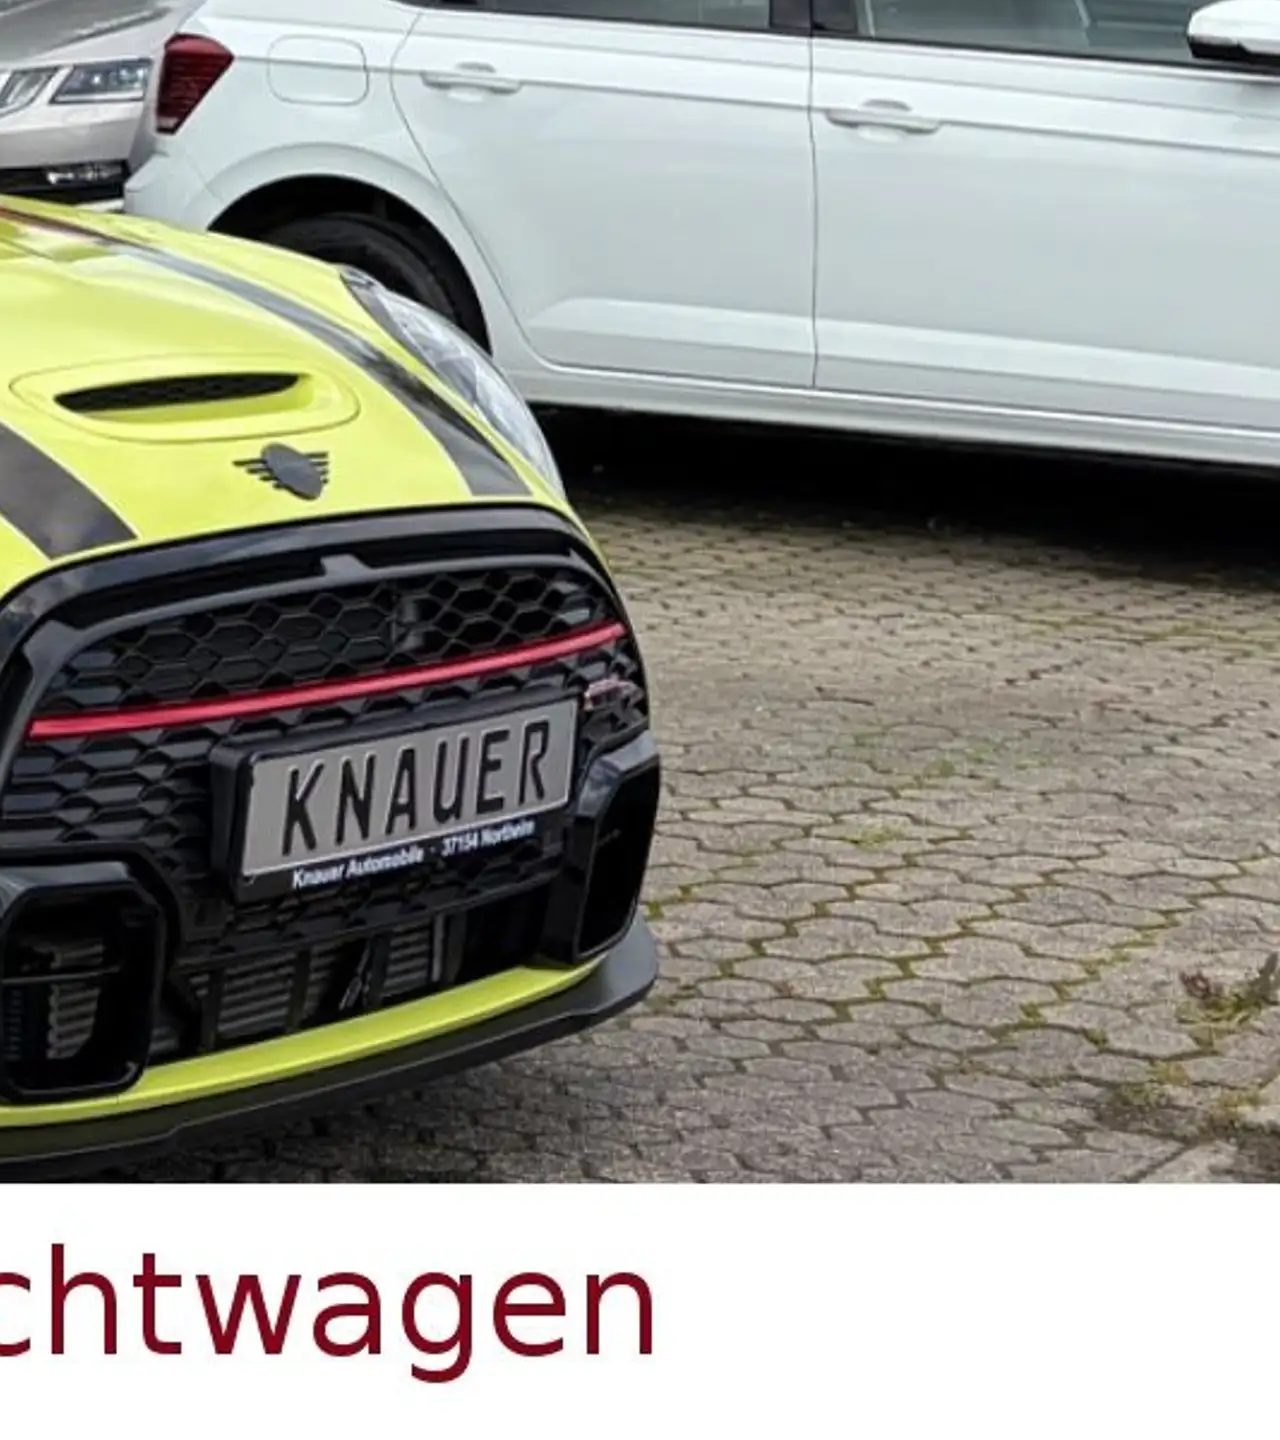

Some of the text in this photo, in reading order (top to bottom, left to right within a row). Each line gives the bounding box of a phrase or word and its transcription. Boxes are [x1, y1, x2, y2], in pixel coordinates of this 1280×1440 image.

[282, 720, 551, 856] KNAUER
[292, 862, 343, 890] Knauer
[345, 844, 426, 878] Automobile
